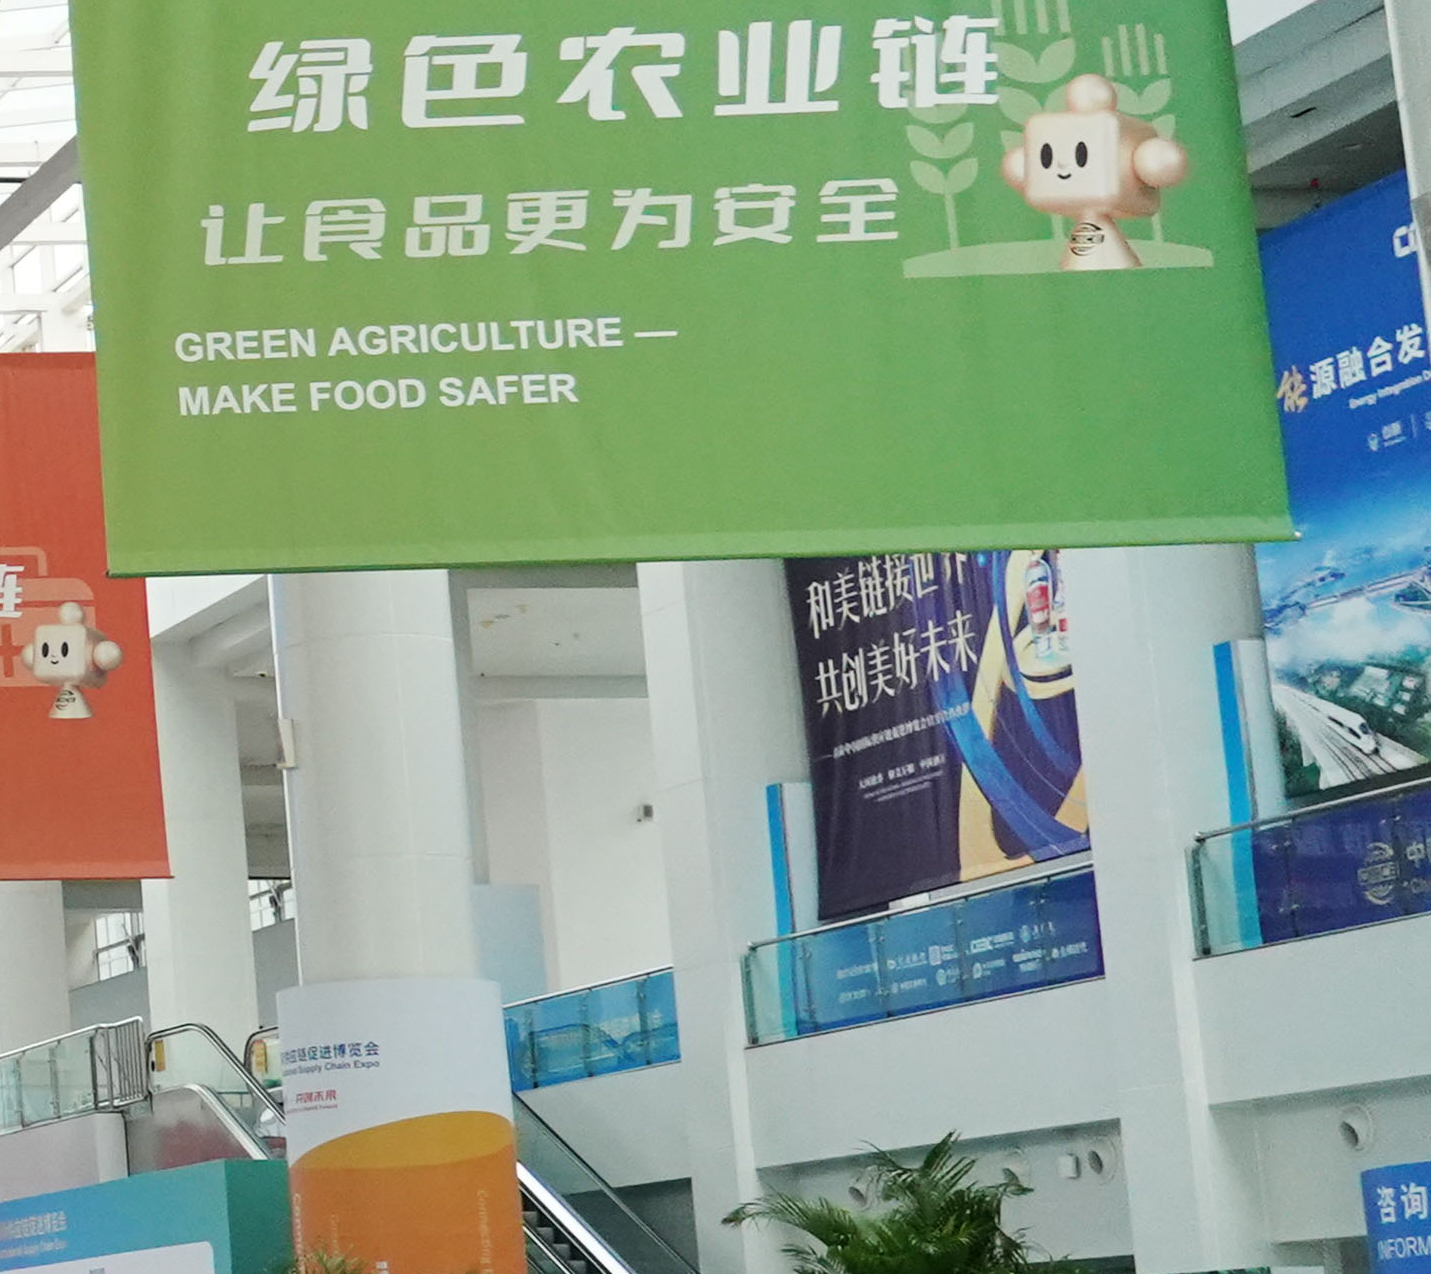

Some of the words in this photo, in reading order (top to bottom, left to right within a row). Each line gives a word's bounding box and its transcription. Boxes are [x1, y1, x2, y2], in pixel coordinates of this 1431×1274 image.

[246, 14, 999, 133] 绿色农业链
[199, 177, 900, 268] 让食品更为安全
[175, 328, 316, 362] GREEN
[328, 317, 623, 356] AGRICULTURE
[179, 383, 297, 415] MAKE
[310, 379, 426, 411] FOOD
[439, 374, 579, 406] SAFER
[815, 609, 977, 717] 共创美好未来
[1377, 1182, 1428, 1224] 咨询
